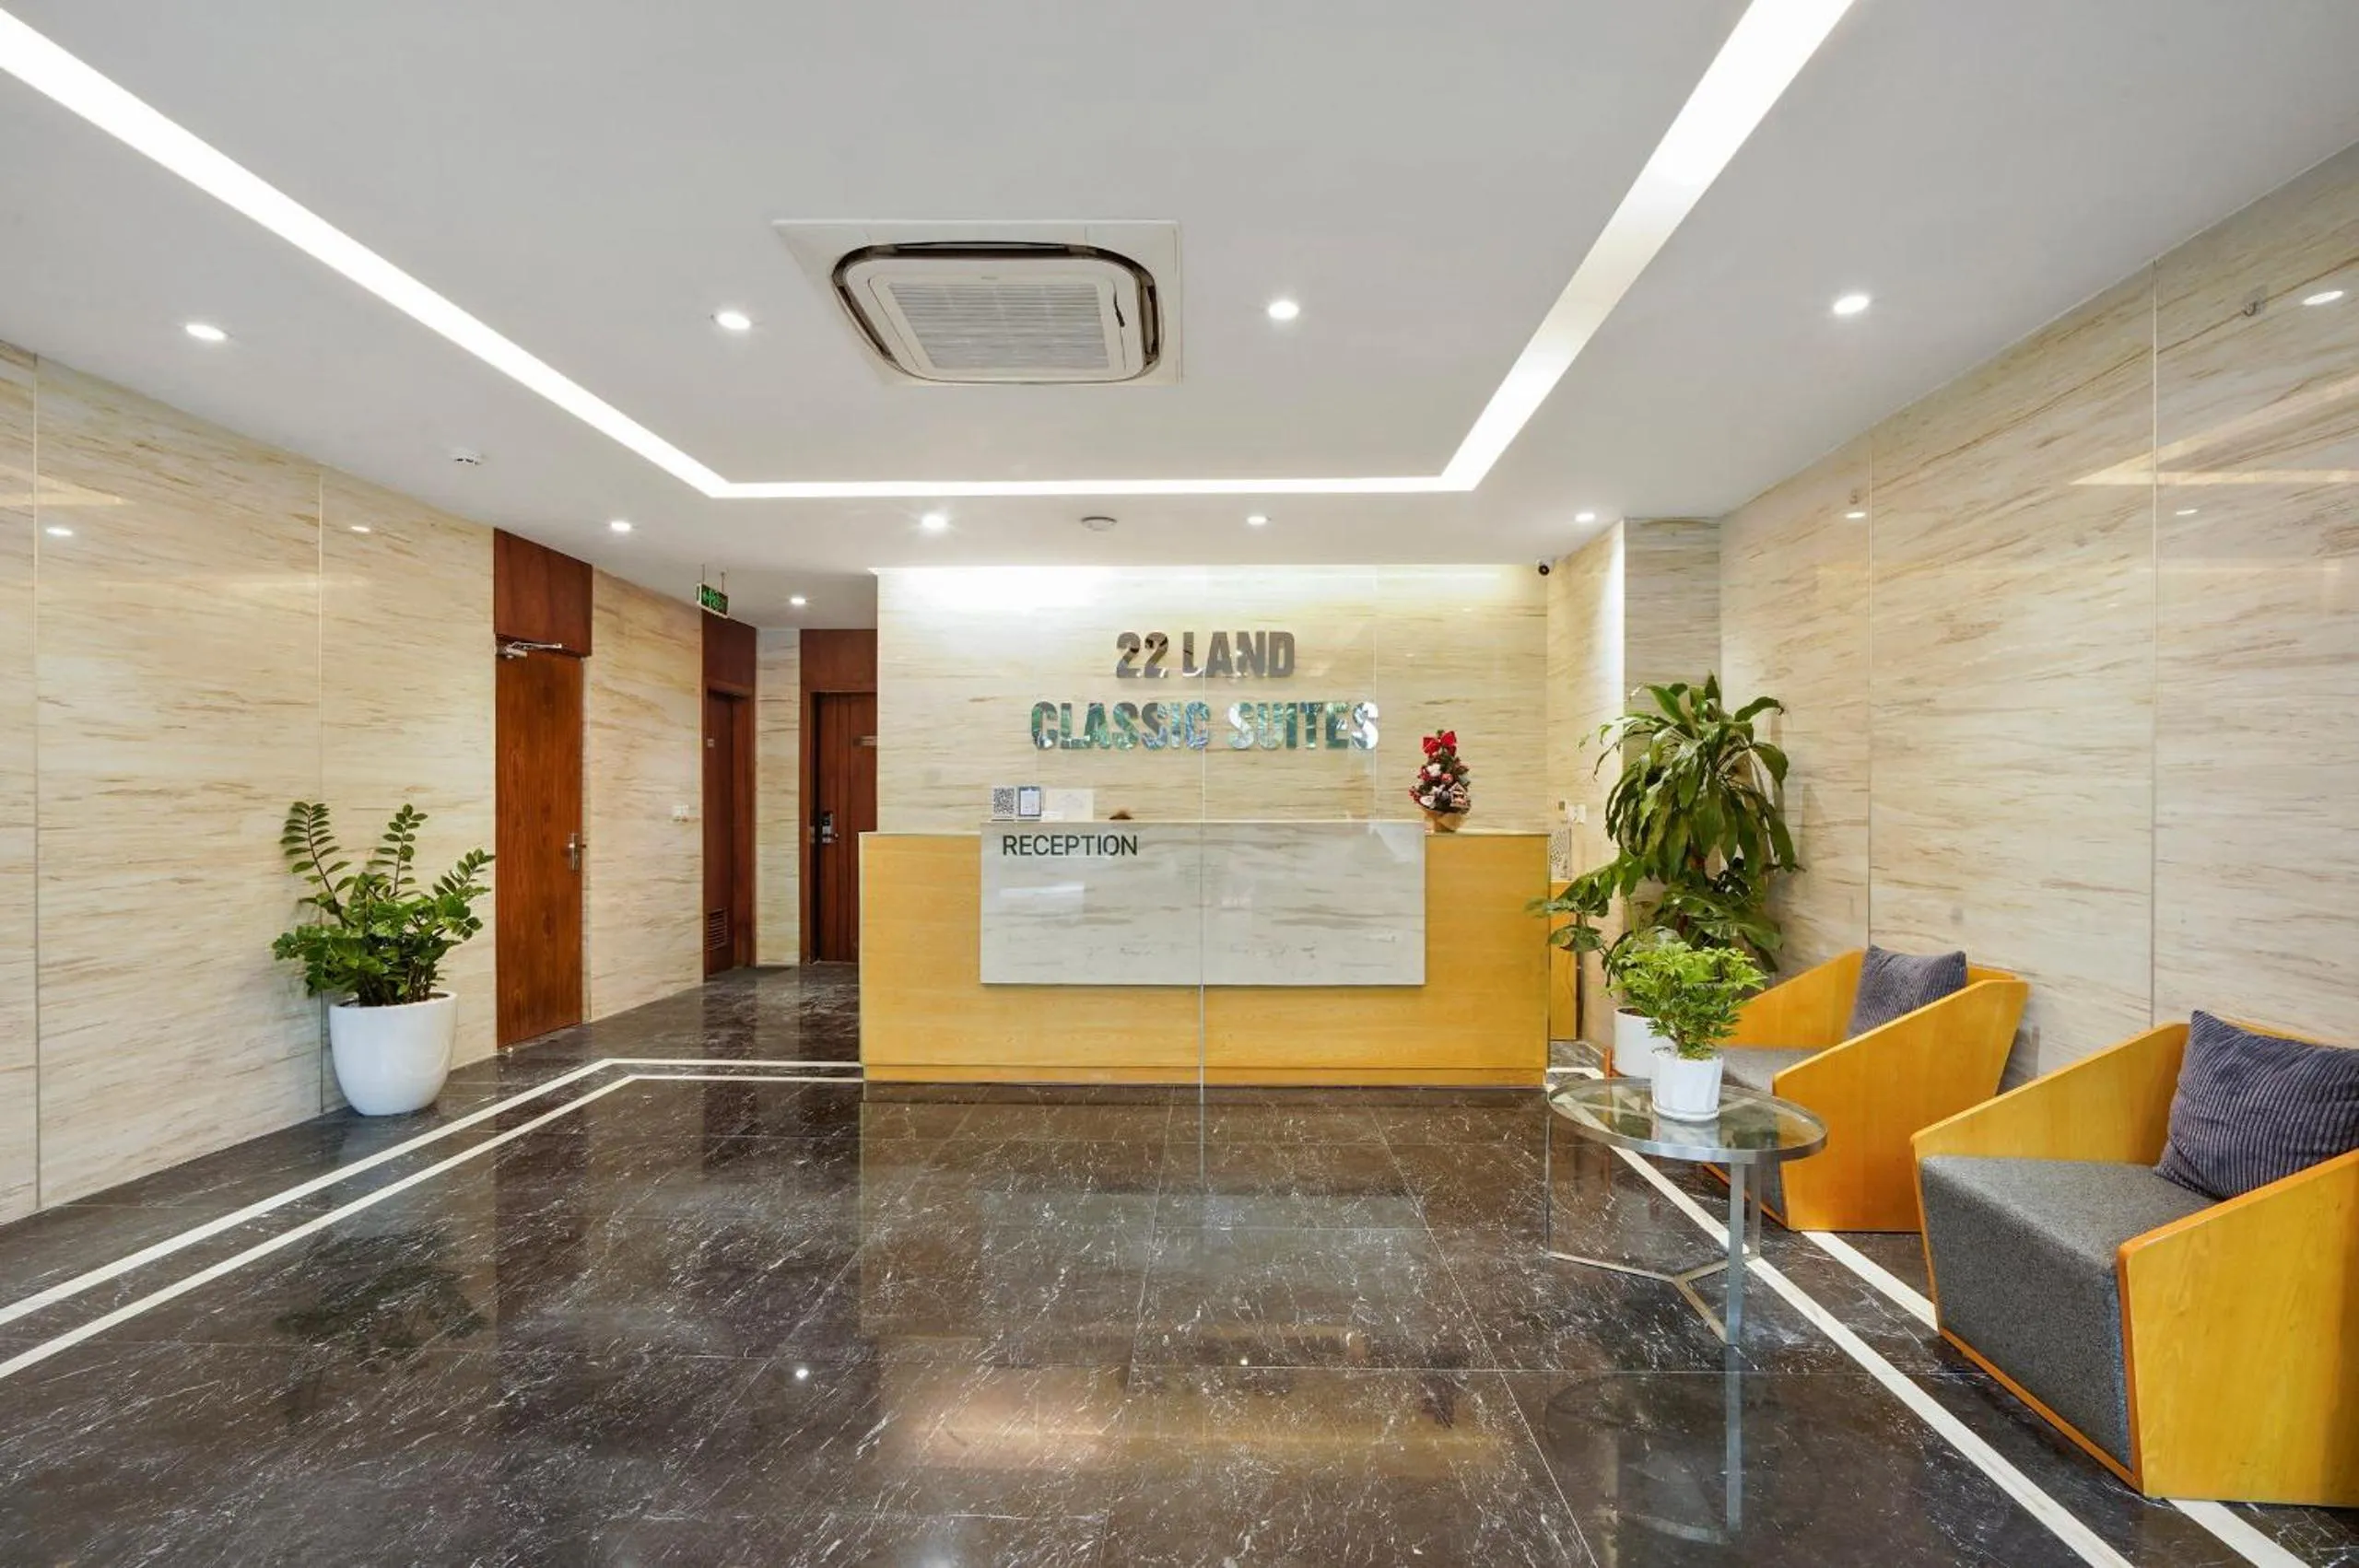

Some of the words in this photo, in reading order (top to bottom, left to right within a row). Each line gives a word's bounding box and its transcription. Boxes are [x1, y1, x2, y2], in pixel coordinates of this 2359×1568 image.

[1116, 631, 1169, 678] 22
[1182, 631, 1295, 678] LAND
[1031, 701, 1210, 750] CLASSIC
[1227, 701, 1379, 750] SUITES
[1003, 835, 1138, 856] RECEPTION
